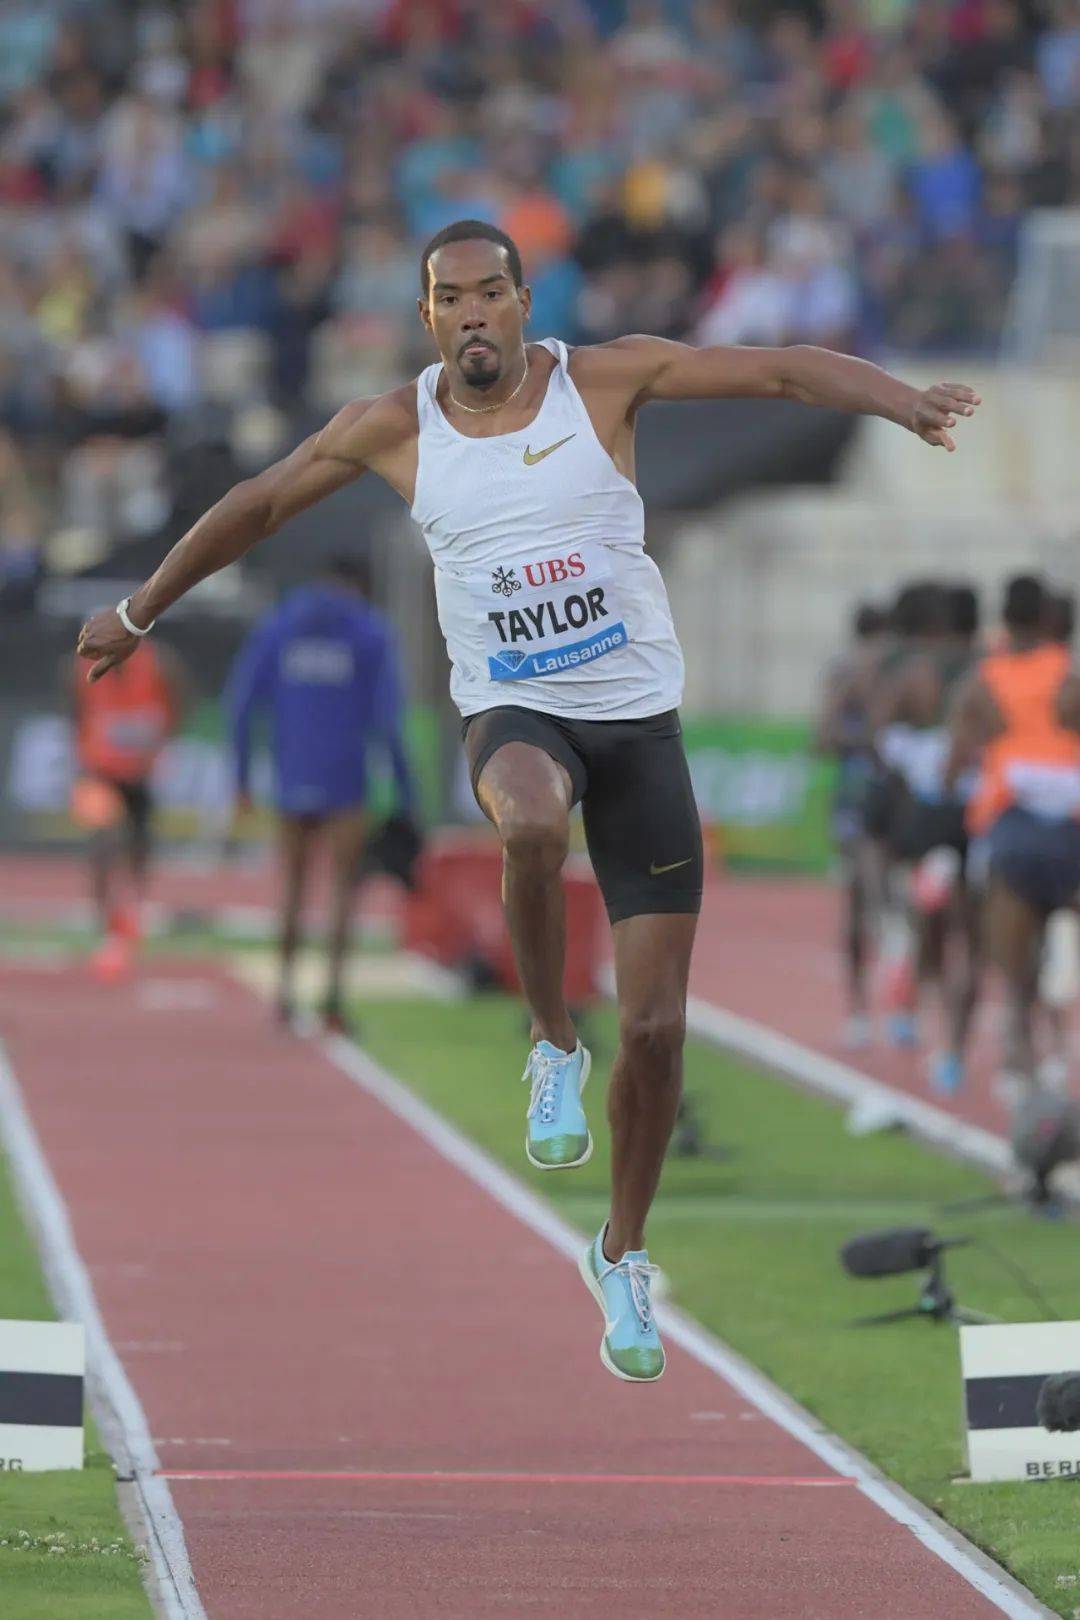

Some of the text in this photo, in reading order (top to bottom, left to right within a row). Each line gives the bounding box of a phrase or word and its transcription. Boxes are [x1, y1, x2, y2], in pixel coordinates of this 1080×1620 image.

[522, 553, 586, 587] UBS
[488, 587, 608, 643] TAYLOR
[532, 631, 623, 674] Lausanne
[1026, 1460, 1080, 1476] BER
